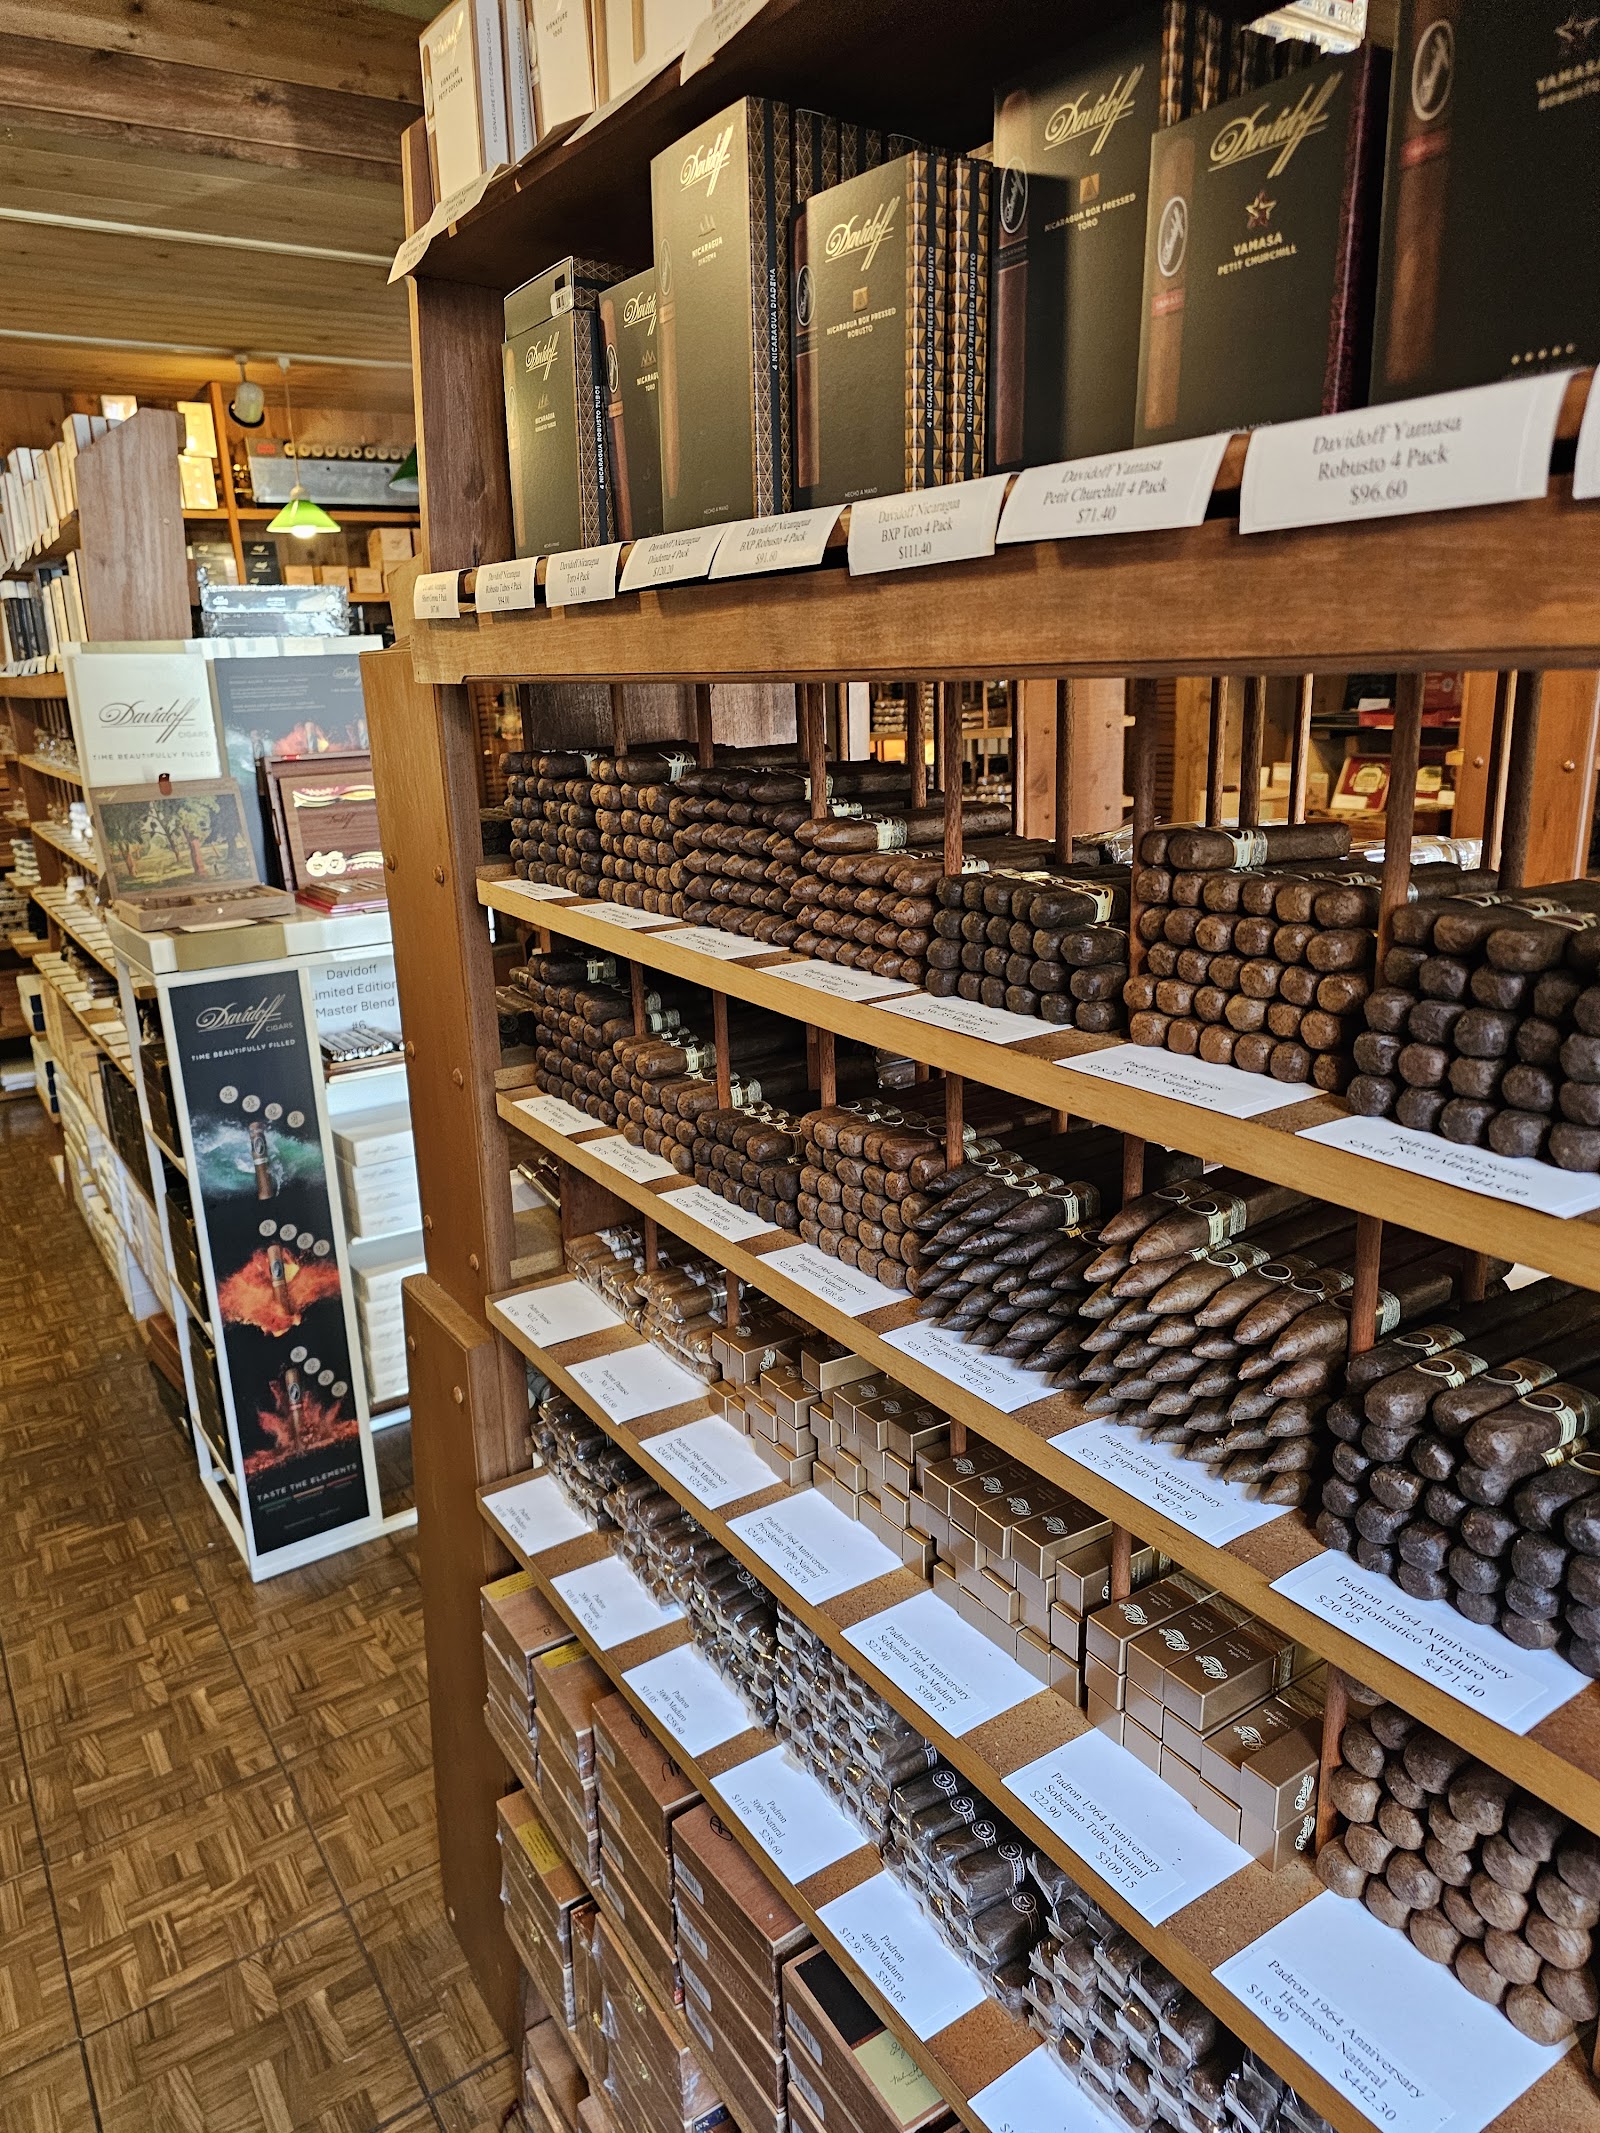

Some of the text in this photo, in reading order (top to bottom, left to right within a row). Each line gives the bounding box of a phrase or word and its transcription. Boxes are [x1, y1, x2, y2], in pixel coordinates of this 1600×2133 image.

[1044, 64, 1145, 157] Davidoff
[1208, 71, 1344, 179] Davidoff
[680, 125, 734, 197] Davidoff
[825, 196, 900, 272] Davidoff
[1044, 193, 1137, 232] NICARAGUA BOX PRESSED
[1078, 218, 1098, 232] TORO
[692, 236, 723, 260] NICARAGUA
[1233, 231, 1283, 257] YAMASA
[827, 307, 897, 336] NICARAGUA BOX PRESSED
[847, 325, 874, 340] ROBUSTO
[526, 331, 560, 382] Davidoff
[1312, 415, 1465, 456] Davidoff Yamasa
[1062, 458, 1164, 484] Davidoff Yamasa
[1318, 444, 1450, 482] Robusto 4 Pack
[878, 497, 961, 524] Davidoff Nicaragua
[1043, 488, 1070, 507] Petit
[1071, 482, 1125, 505] Churchill
[1138, 478, 1168, 496] Pack
[1349, 480, 1409, 507] $96.60
[746, 523, 778, 538] Davidoff
[881, 528, 901, 543] BXP
[902, 525, 924, 539] Toro
[932, 518, 954, 534] Pack
[1076, 506, 1118, 526] $71.40
[755, 535, 784, 549] Robusto
[791, 531, 808, 544] Pack
[898, 542, 933, 561] $111.40
[99, 697, 200, 744] Davidoff
[118, 752, 178, 760] BEAUTIFULLY
[327, 964, 377, 980] Davidoff
[196, 994, 286, 1040] Davidoff
[266, 1022, 294, 1032] CIGARS
[315, 997, 395, 1018] Master Blend
[191, 1039, 296, 1062] TIME BEAUTIFULLY FILLED
[904, 1341, 995, 1394] $23.75 $427.50
[925, 1331, 1019, 1385] Padron 1964 Anniversary
[930, 1343, 992, 1381] Torpedo Maduro
[257, 1486, 287, 1502] TASTE
[290, 1480, 308, 1491] THE
[310, 1462, 358, 1484] ELEMENTS
[1077, 1448, 1198, 1521] $23.75 $427.50
[1099, 1434, 1224, 1509] Padron 1964 Anniversary
[1109, 1452, 1193, 1503] Torpedo Natural
[764, 1516, 785, 1534] Padron
[796, 1545, 831, 1575] Anniversary
[782, 1546, 798, 1561] Tubo
[796, 1559, 821, 1579] Natural
[1314, 1594, 1486, 1699] $20.95 $471.40
[1336, 1575, 1515, 1680] Padron 1964 Anniversary
[1338, 1592, 1485, 1682] Diplomatico Maduro
[865, 1640, 948, 1713] $22.90 $309.15
[878, 1634, 957, 1706] Soberano Tubo Maduro
[886, 1625, 971, 1700] Padron 1964 Anniversary
[732, 1794, 783, 1856] $11.05 $258.60
[750, 1799, 786, 1839] 3000 Natural
[767, 1800, 787, 1824] Padron
[1044, 1784, 1149, 1880] Soberano Tubo Natural
[1050, 1772, 1164, 1874] Padron 1964 Anniversary
[1029, 1790, 1138, 1889] $22.90 $309.15
[839, 1927, 907, 2003] $12.95 $303.05
[862, 1933, 905, 1983] 4000 Maduro
[880, 1935, 905, 1963] Padron
[1267, 1960, 1425, 2100] Padron 1964 Anniversary
[1278, 1990, 1388, 2090] Hermoso Natural
[1246, 1983, 1397, 2122] $18.90 $442.30
